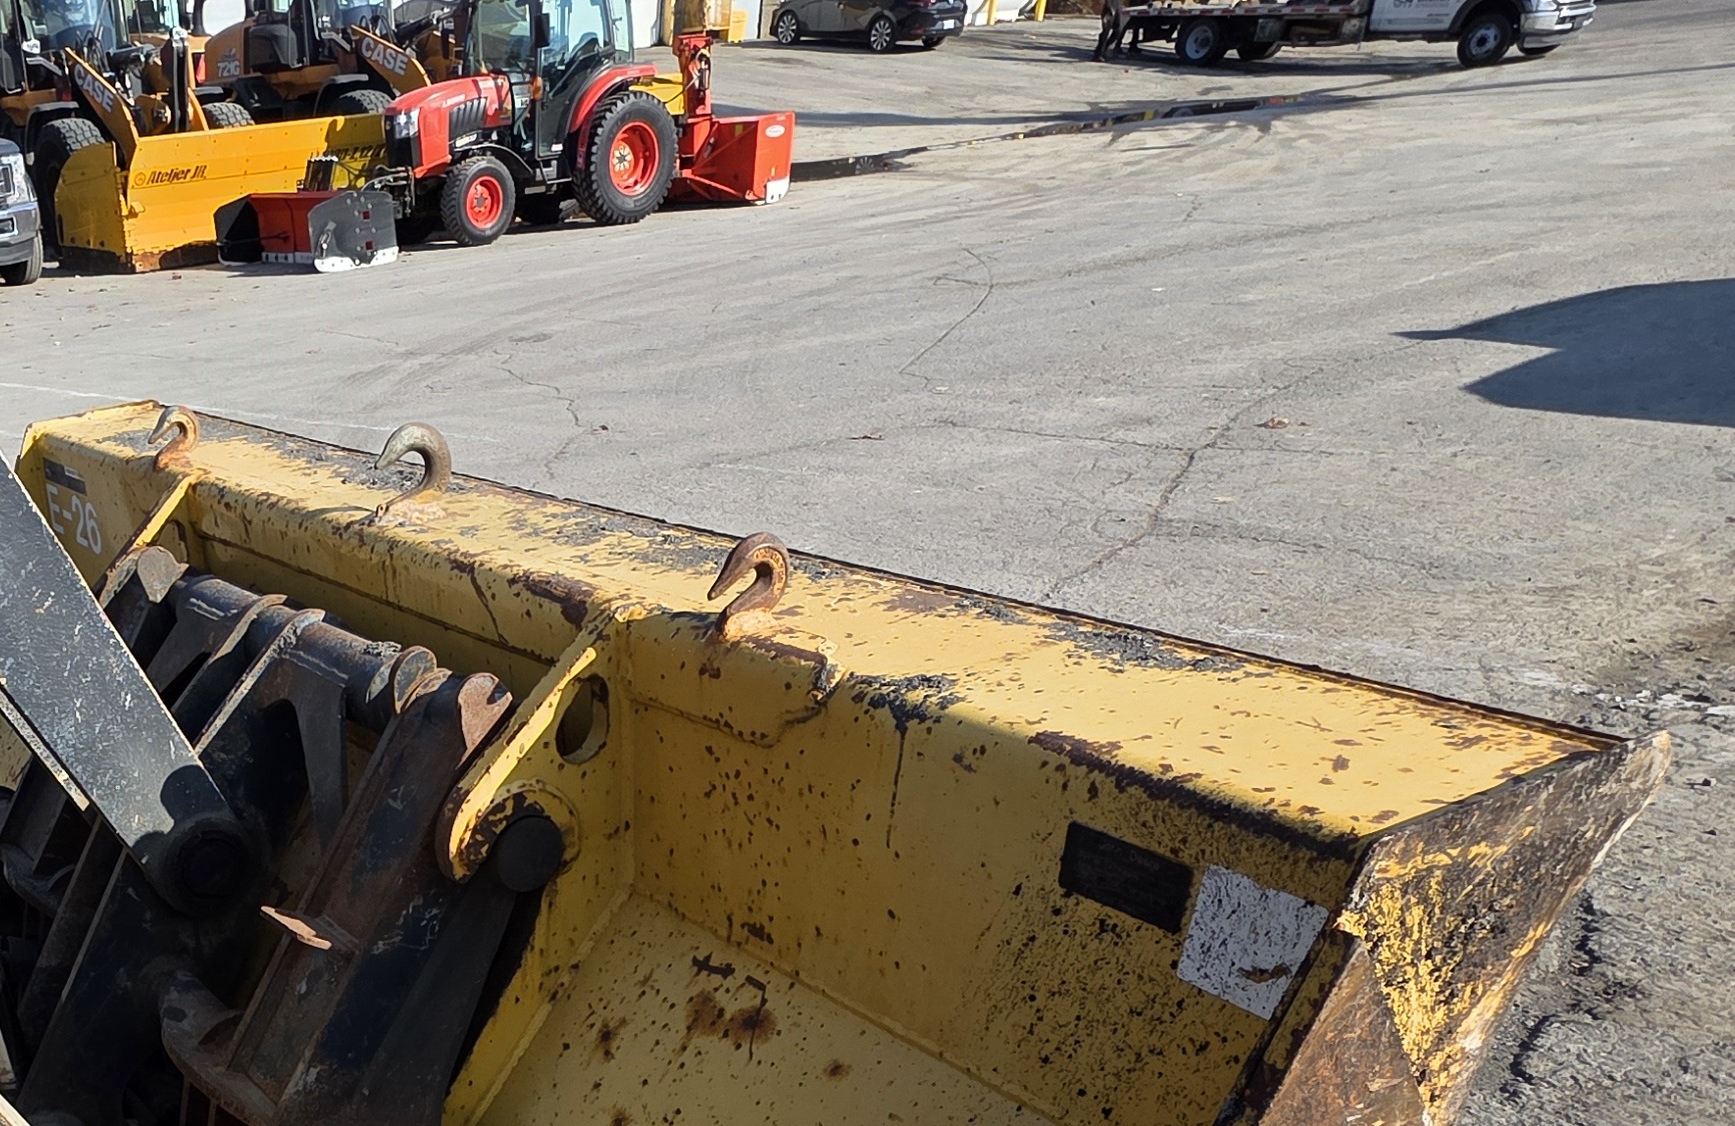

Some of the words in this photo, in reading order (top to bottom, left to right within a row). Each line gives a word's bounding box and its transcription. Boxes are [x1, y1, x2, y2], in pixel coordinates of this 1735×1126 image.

[361, 36, 409, 76] CASE
[74, 63, 114, 113] CASE
[46, 483, 101, 555] E-26
